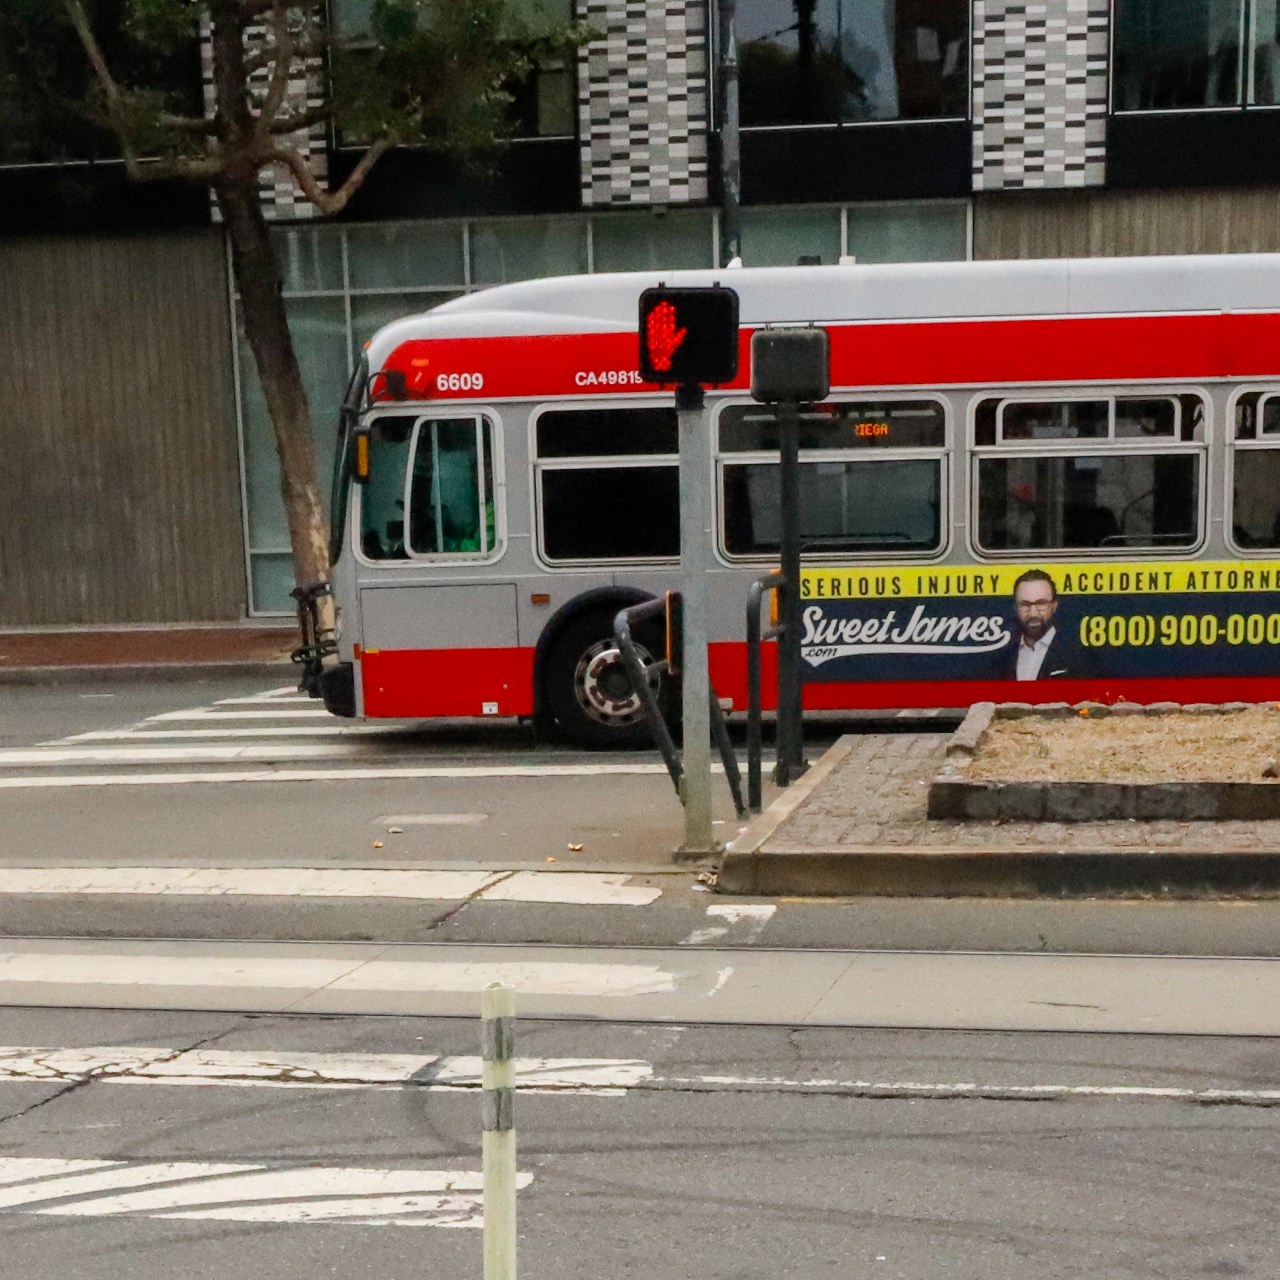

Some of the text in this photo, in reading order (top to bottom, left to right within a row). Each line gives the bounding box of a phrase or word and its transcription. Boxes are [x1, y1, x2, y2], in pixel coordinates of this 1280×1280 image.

[436, 373, 484, 392] 6609
[802, 577, 902, 597] SERIOUS
[917, 575, 1000, 595] INJURY
[1063, 572, 1173, 592] ACCIDENT
[1079, 615, 1156, 647] (800)
[804, 646, 838, 658] .com
